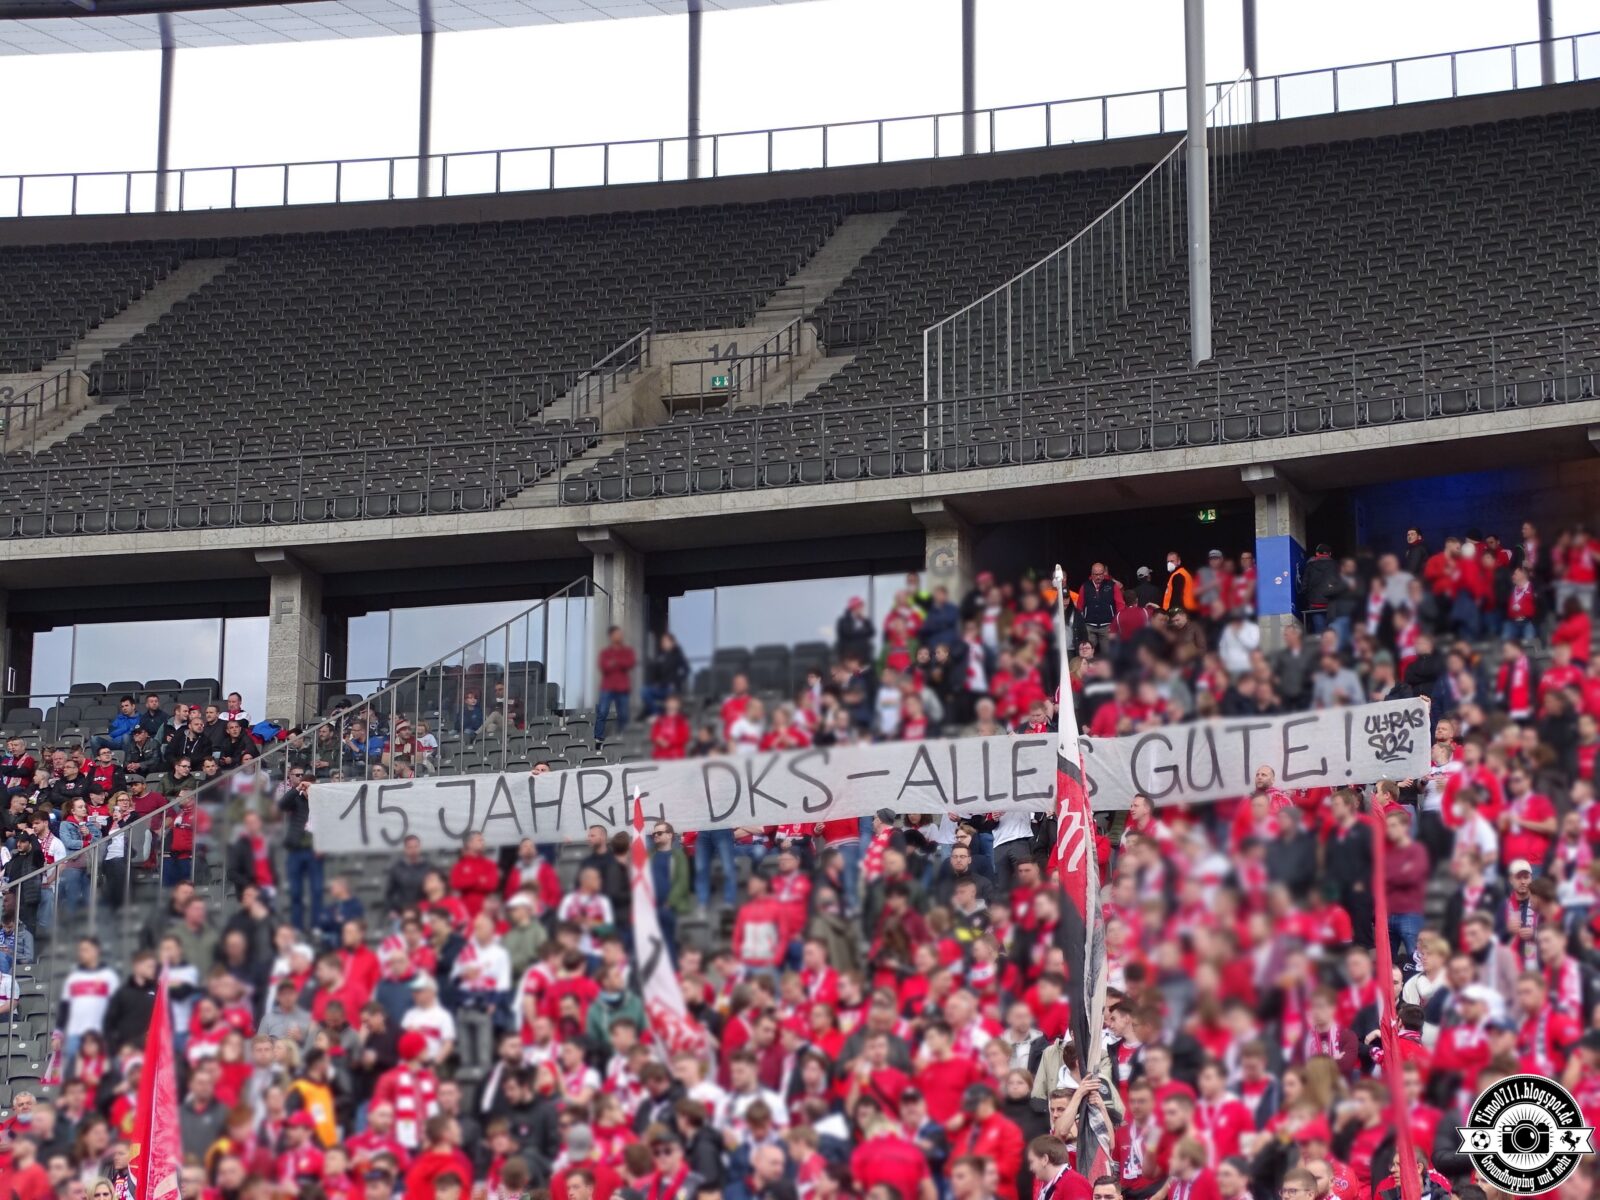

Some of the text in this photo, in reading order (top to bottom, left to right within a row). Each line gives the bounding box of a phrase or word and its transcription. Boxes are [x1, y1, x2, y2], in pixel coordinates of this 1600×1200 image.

[708, 341, 740, 366] 14
[929, 546, 954, 577] G
[275, 595, 295, 624] F
[1364, 708, 1425, 734] ULTRAS
[340, 781, 411, 847] 15
[435, 766, 665, 840] JAHRE
[701, 750, 834, 823] DKS
